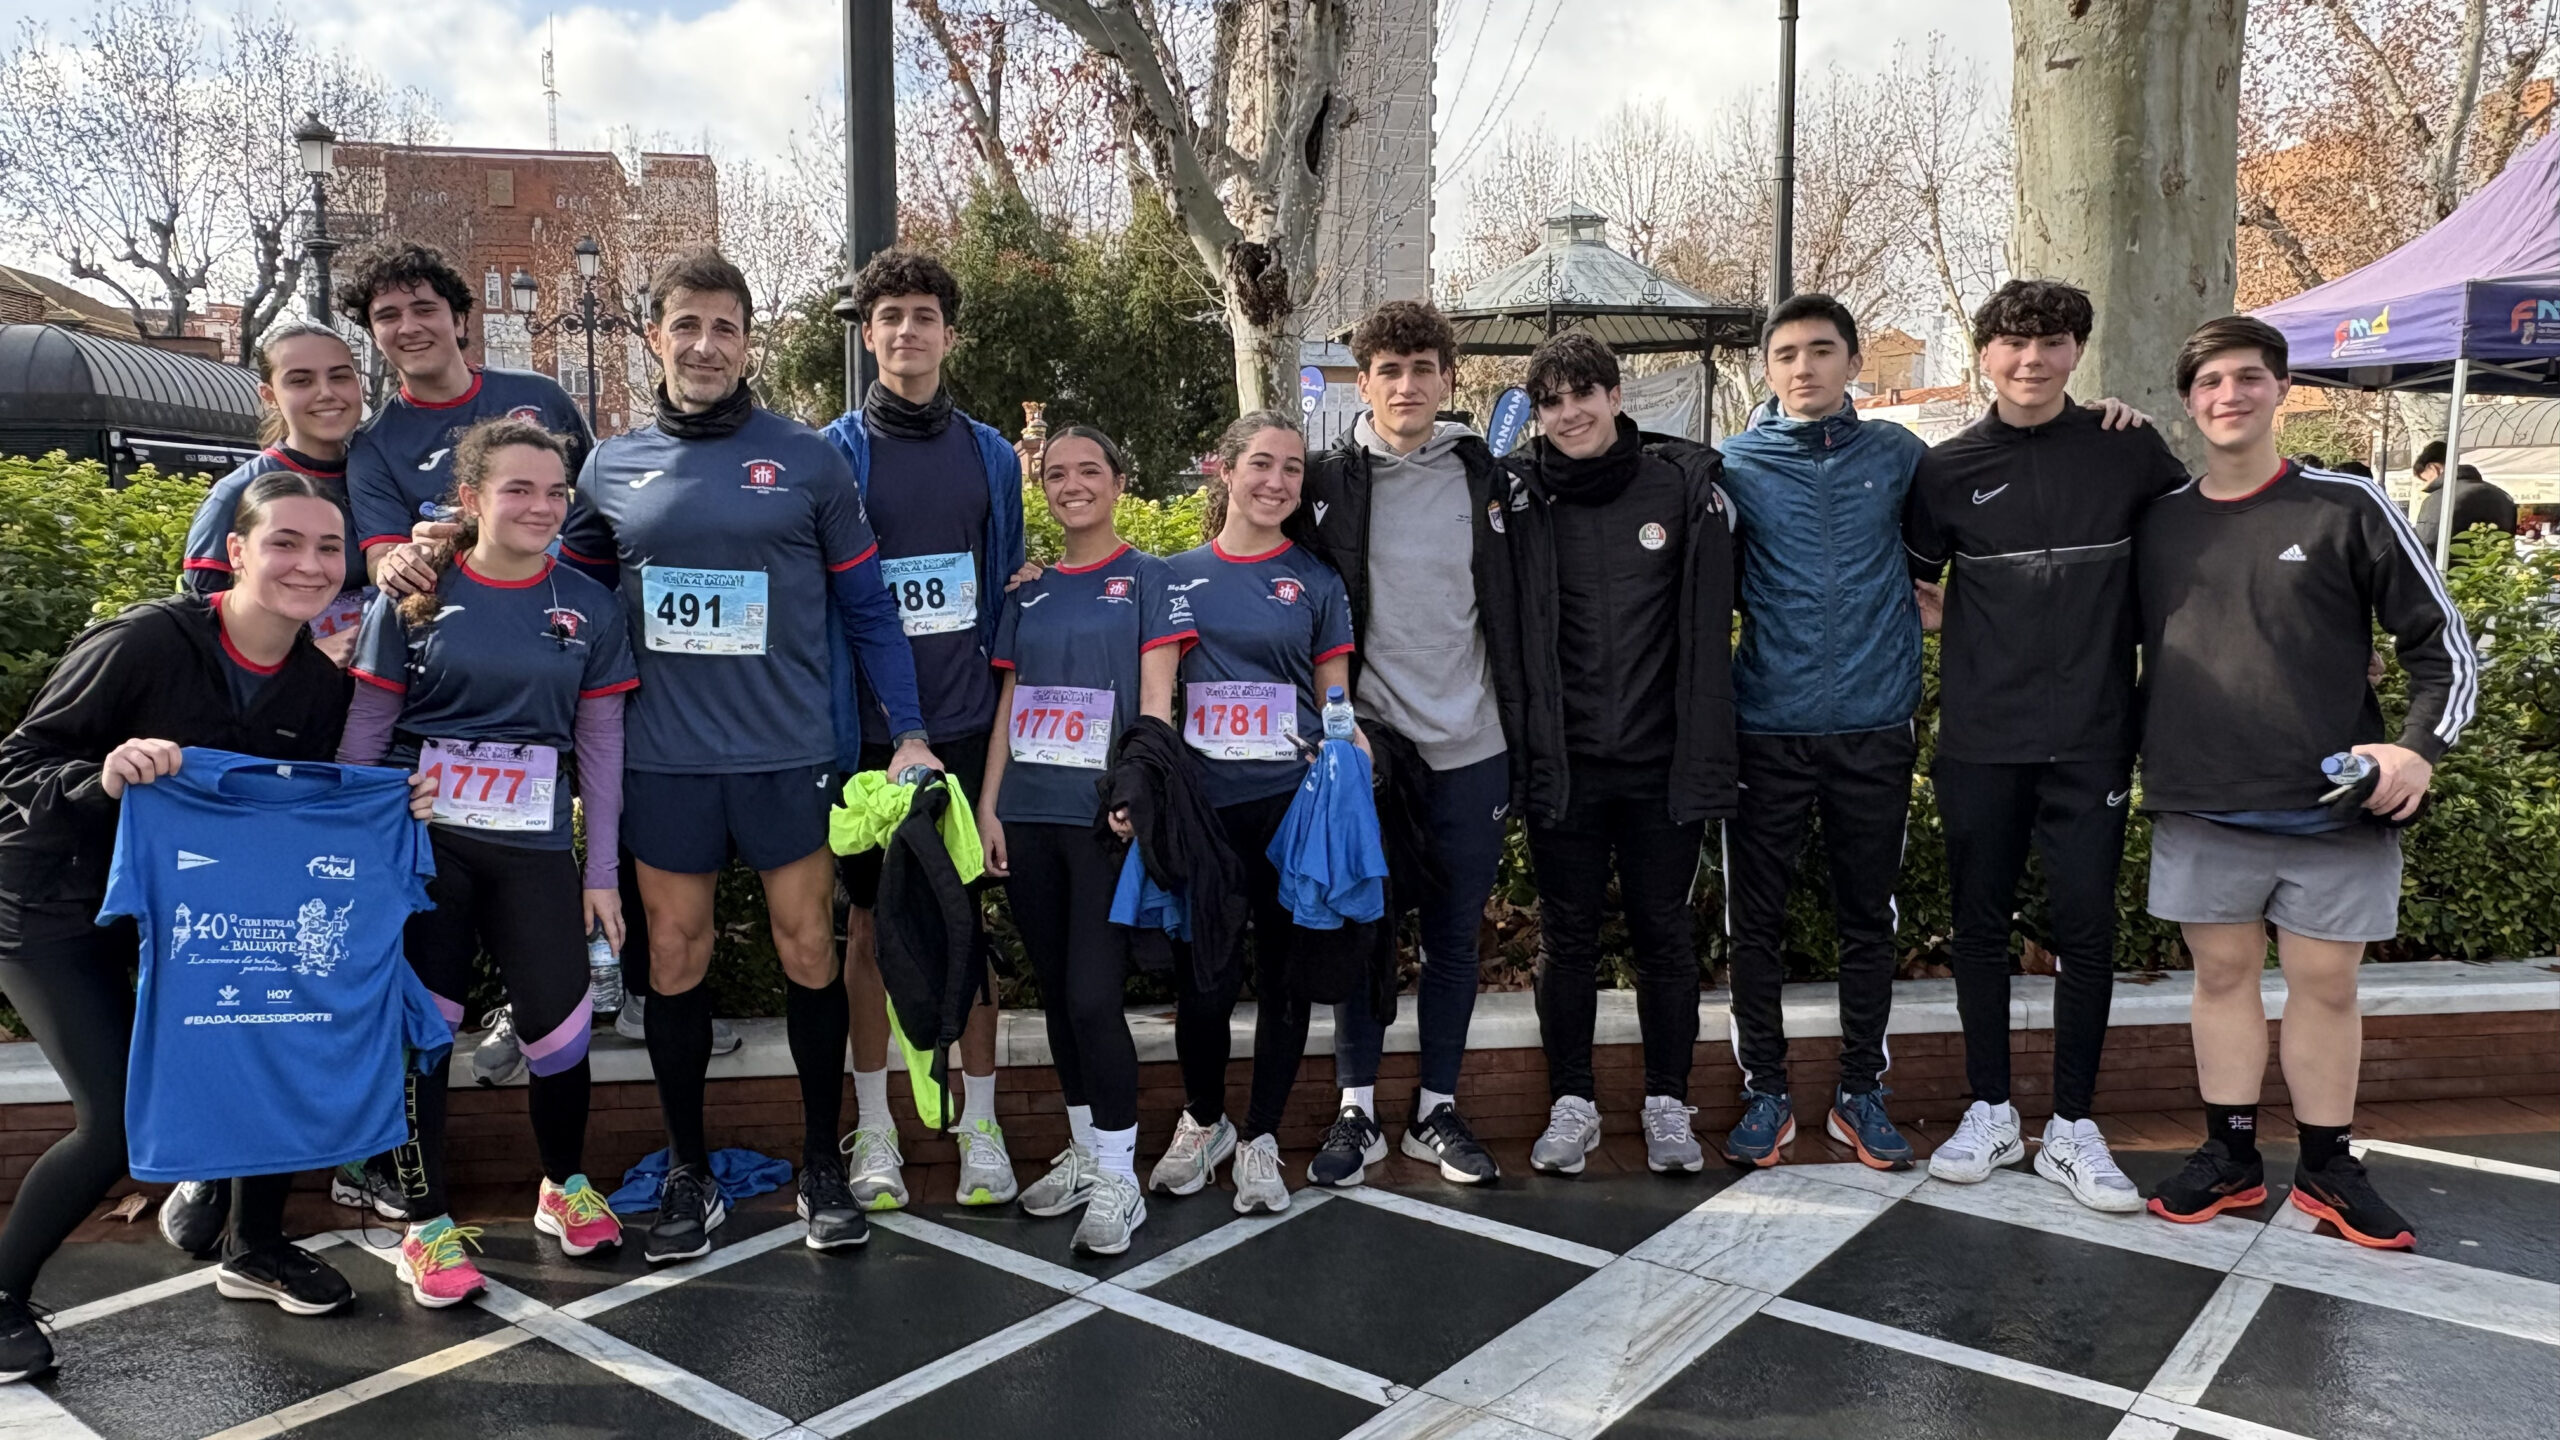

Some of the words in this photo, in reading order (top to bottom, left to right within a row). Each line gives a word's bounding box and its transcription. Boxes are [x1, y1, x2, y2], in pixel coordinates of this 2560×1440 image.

[691, 577, 701, 586] AL
[657, 591, 721, 628] 491
[1016, 708, 1085, 742] 1776
[1193, 704, 1268, 736] 1781
[478, 751, 490, 759] AL
[426, 762, 527, 804] 1777
[232, 927, 287, 939] VUELTA
[229, 940, 298, 953] BALUARTE
[266, 989, 293, 1000] HOY
[184, 1013, 333, 1025] #BADAJOZESDEPORTE
